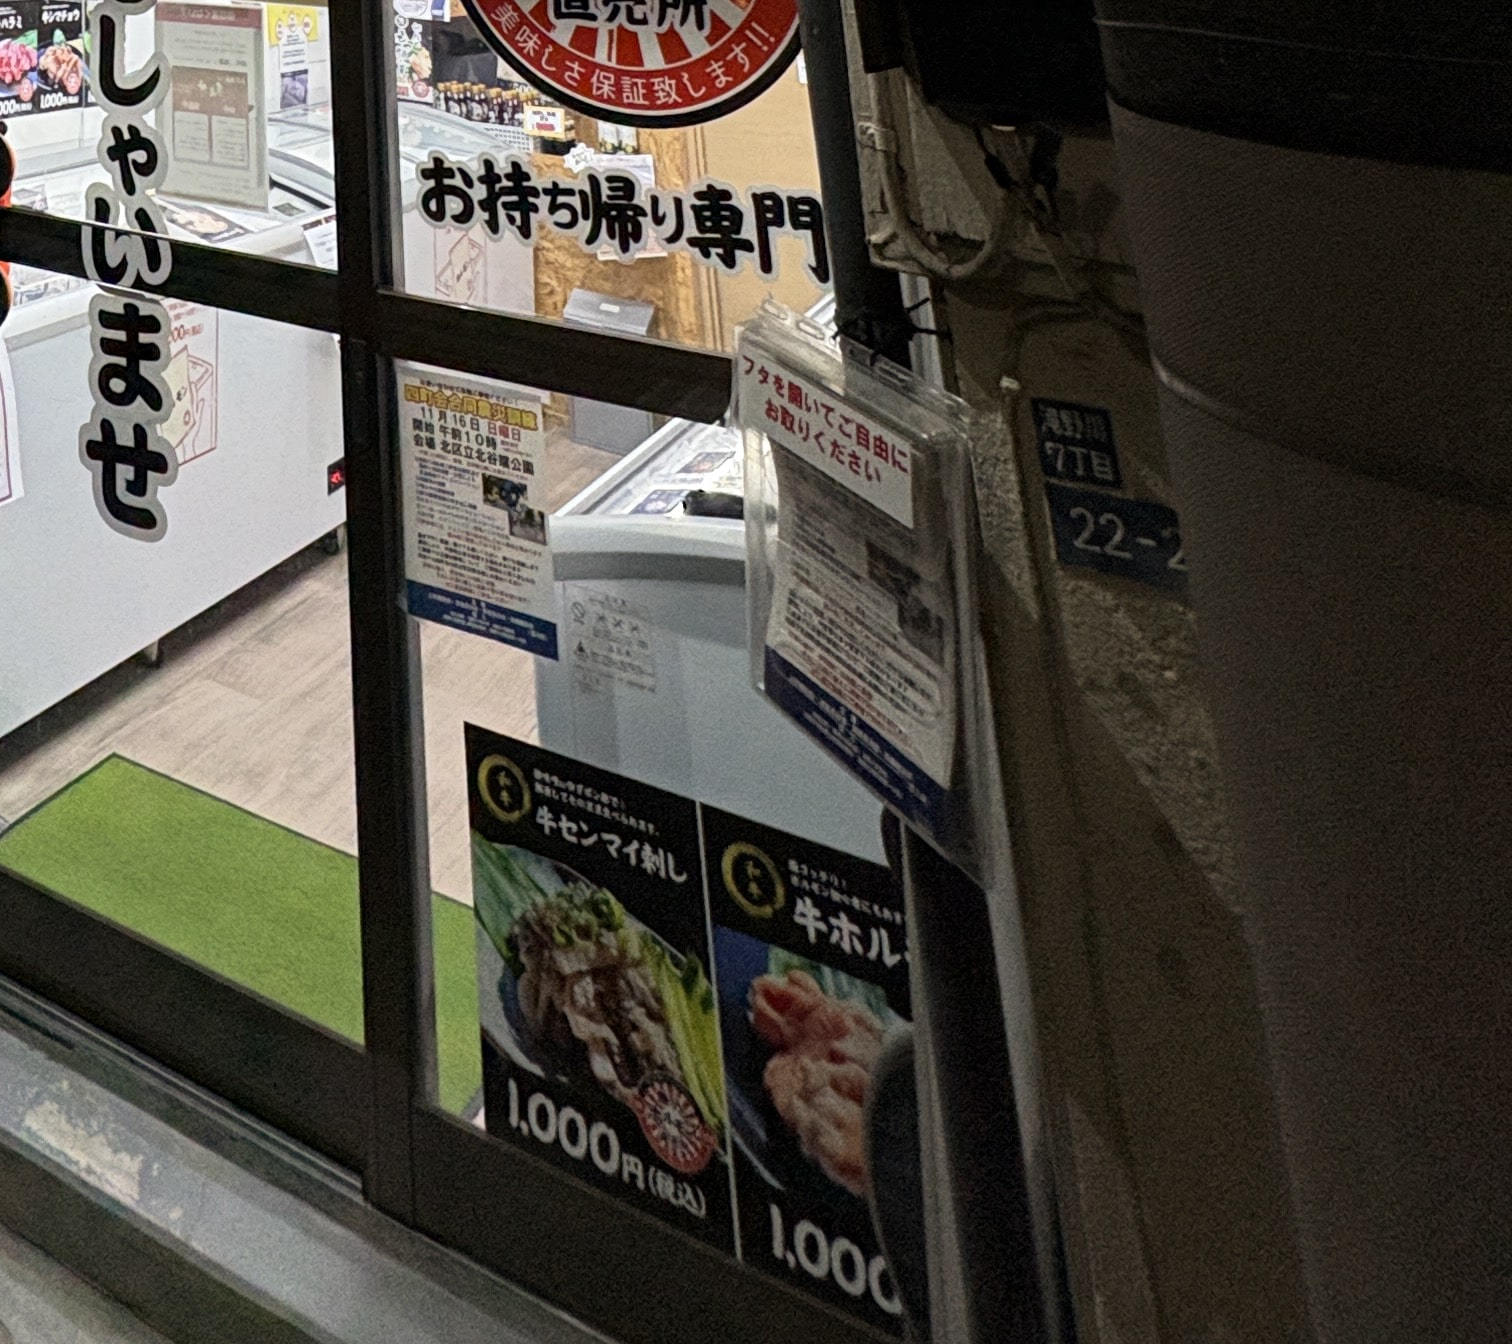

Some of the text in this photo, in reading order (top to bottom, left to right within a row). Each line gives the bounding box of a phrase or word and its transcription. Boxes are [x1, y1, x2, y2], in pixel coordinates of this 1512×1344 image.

[490, 0, 776, 108] 美味しさ保証致します!!
[743, 354, 909, 474] フタを開いてご自由に
[764, 397, 882, 485] お取りください
[536, 804, 687, 885] 牛センマイ刺し
[793, 895, 911, 969] 牛ホル
